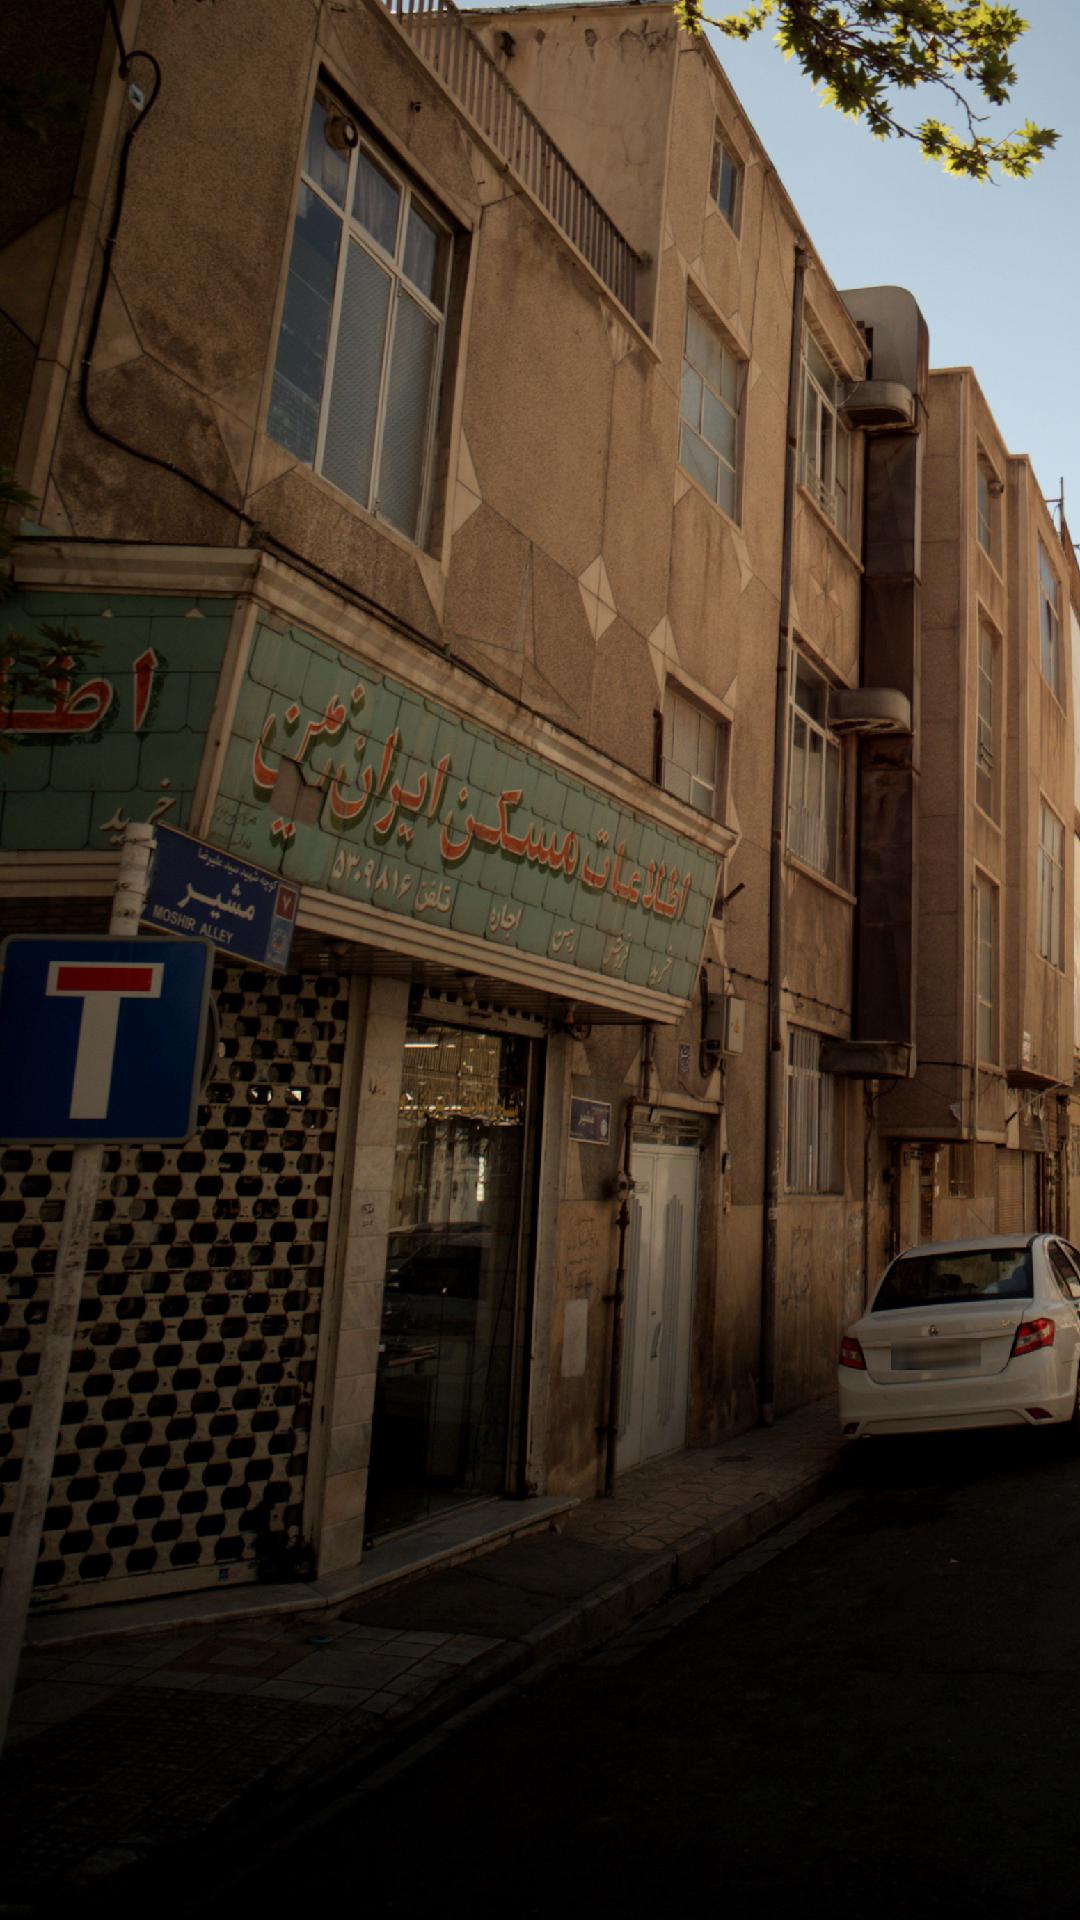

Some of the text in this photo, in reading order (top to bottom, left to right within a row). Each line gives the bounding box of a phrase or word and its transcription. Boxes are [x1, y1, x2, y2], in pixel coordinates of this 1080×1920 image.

[330, 726, 450, 841] ایران
[99, 777, 177, 848] خید
[441, 787, 578, 876] مسکن
[176, 881, 256, 921] مشیر
[414, 880, 451, 912] تلفن
[582, 828, 691, 919] اطلاعات
[152, 904, 235, 945] MOSHIR ALLEY
[489, 903, 523, 940] اجاره
